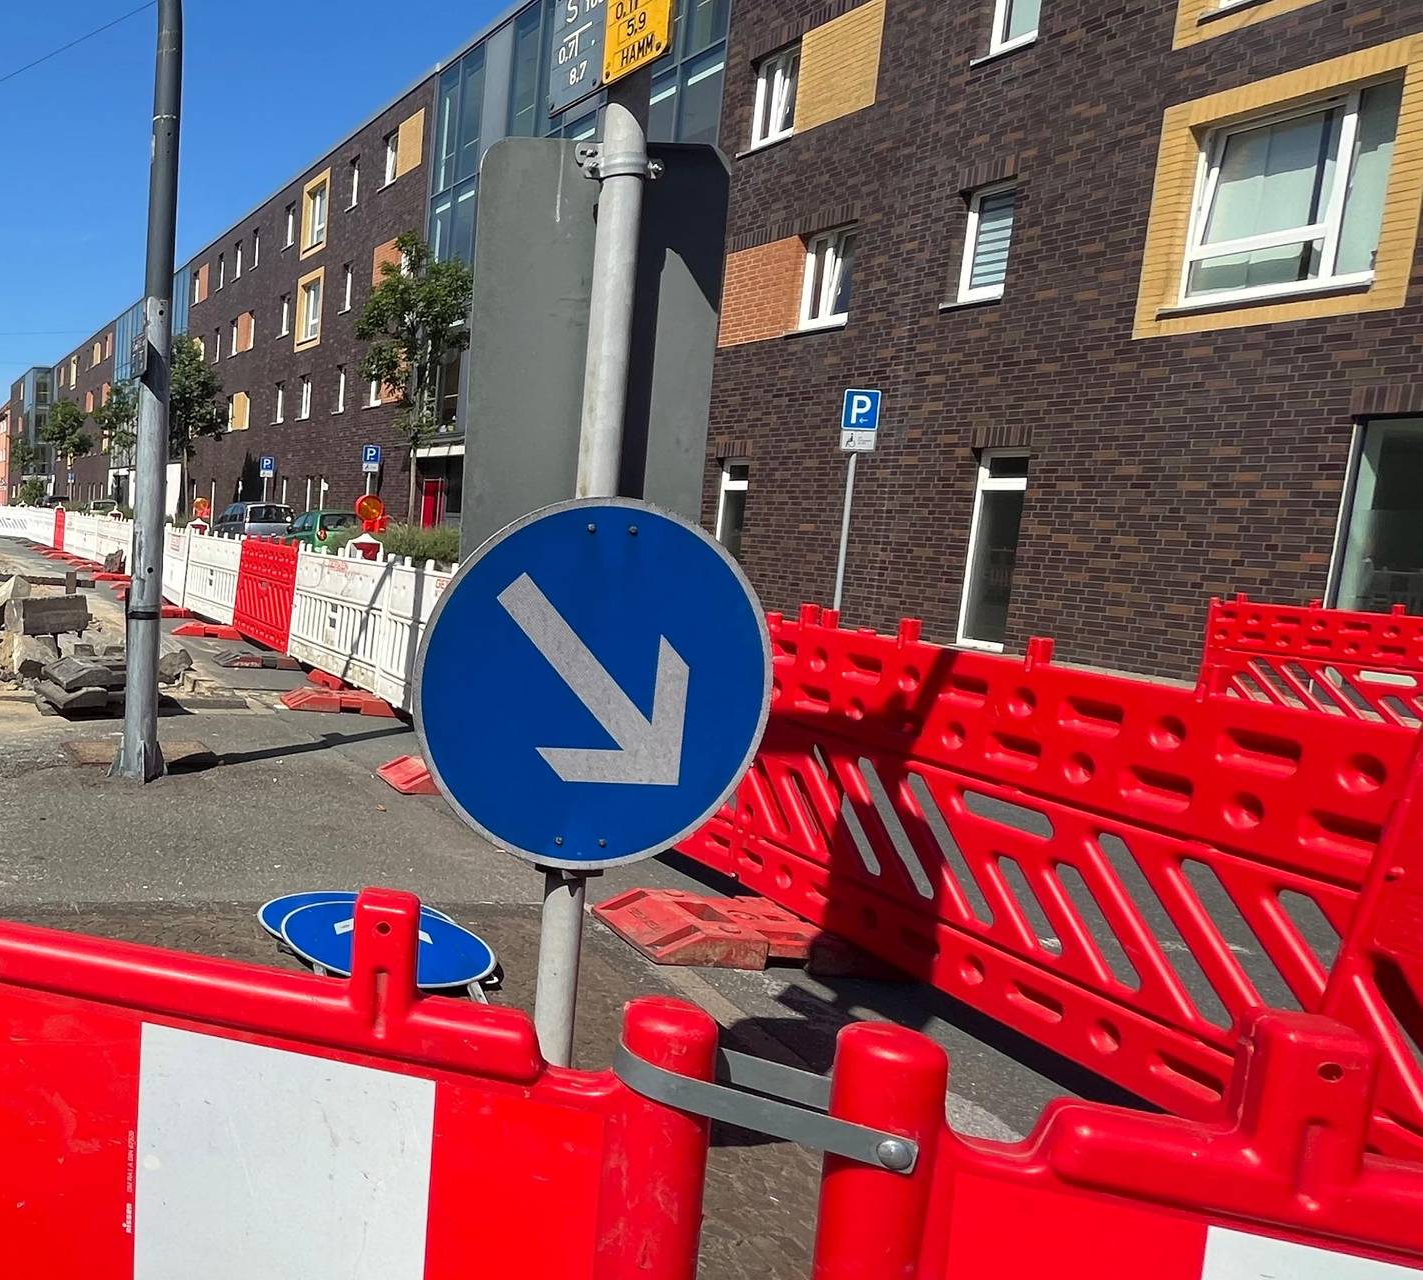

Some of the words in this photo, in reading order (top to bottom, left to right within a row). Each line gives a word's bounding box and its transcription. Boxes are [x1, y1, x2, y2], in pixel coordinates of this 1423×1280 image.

[566, 0, 579, 23] S
[620, 33, 654, 67] HAMM
[850, 395, 872, 424] P
[263, 458, 272, 469] P
[366, 447, 377, 461] P
